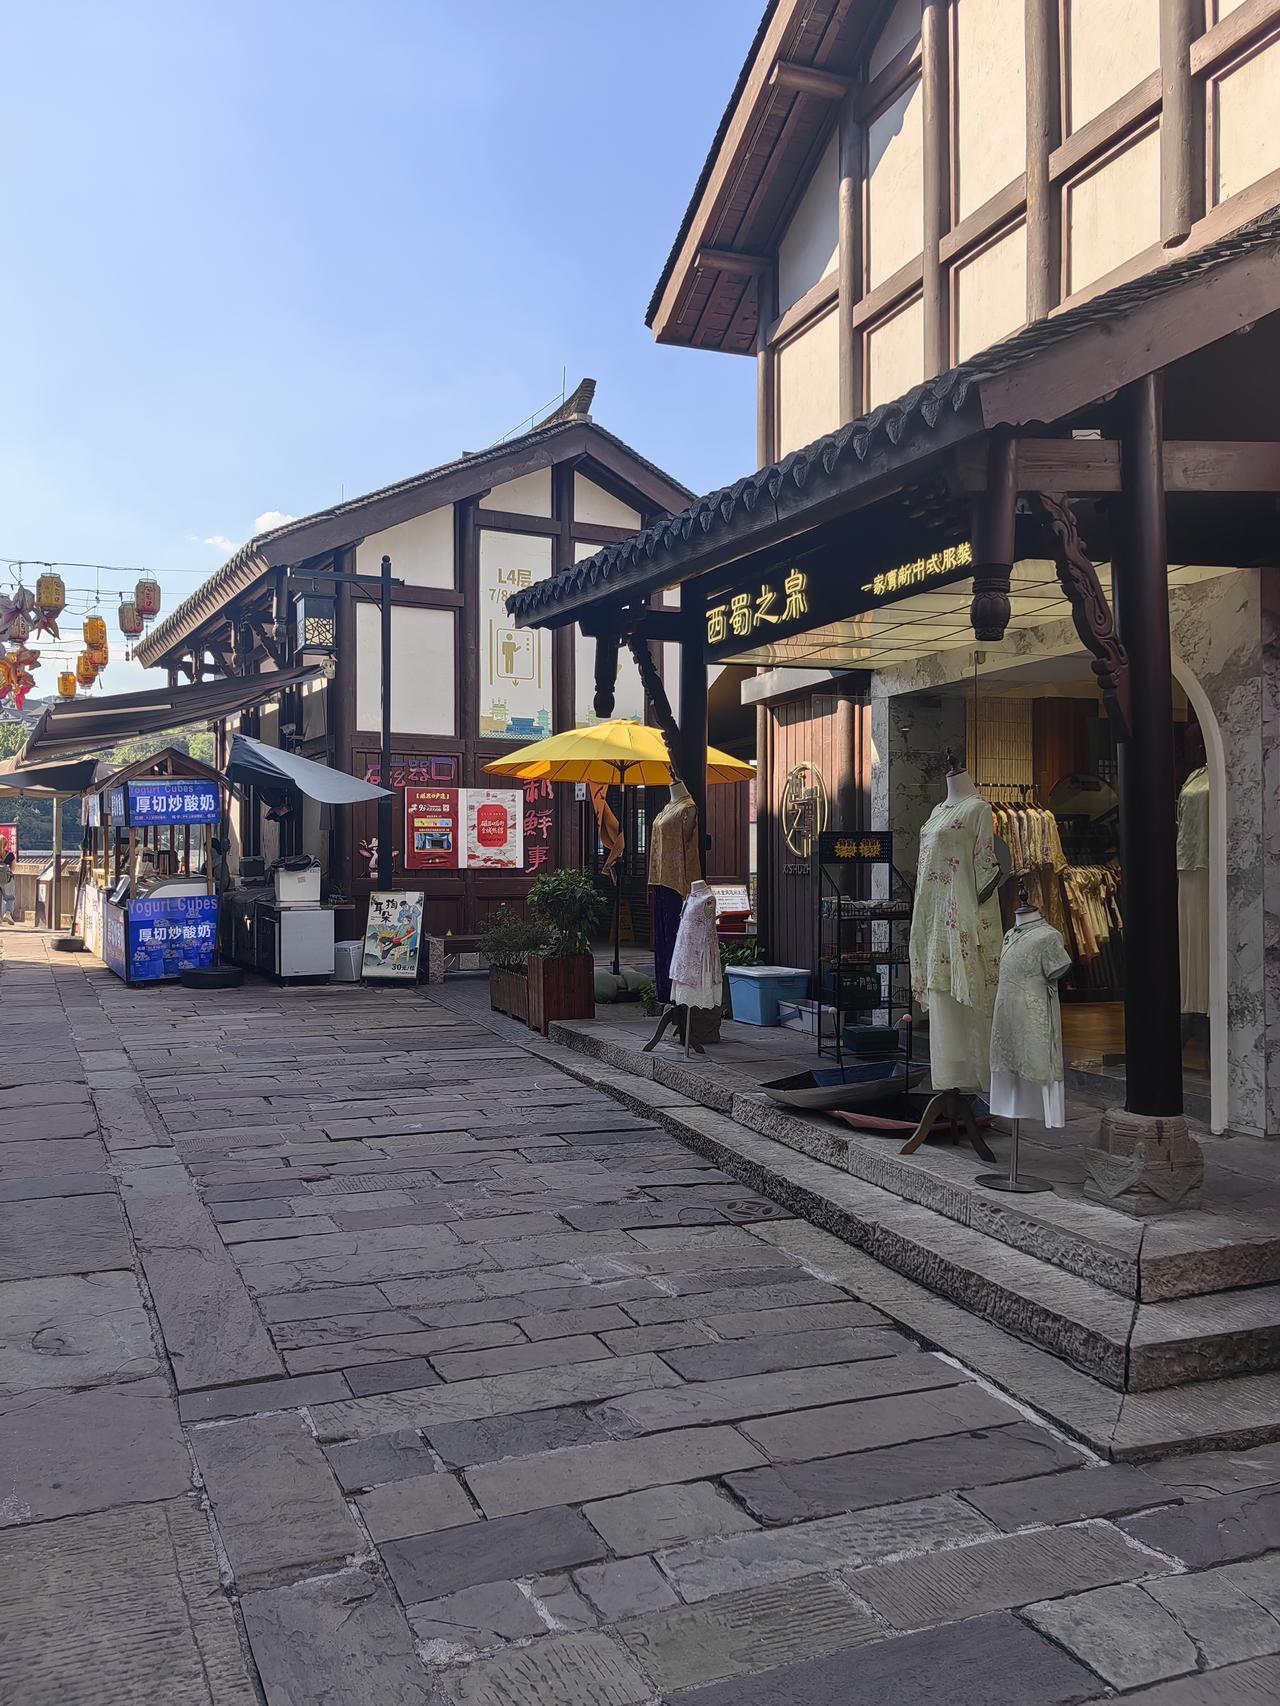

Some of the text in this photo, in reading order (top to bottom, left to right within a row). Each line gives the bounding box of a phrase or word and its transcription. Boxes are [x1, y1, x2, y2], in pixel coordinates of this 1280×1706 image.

[498, 567, 532, 587] L4层
[164, 784, 194, 794] Cubes
[136, 793, 215, 813] 厚切炒酸奶
[129, 896, 218, 917] Yogurt Cubes
[138, 924, 211, 942] 厚切炒酸奶
